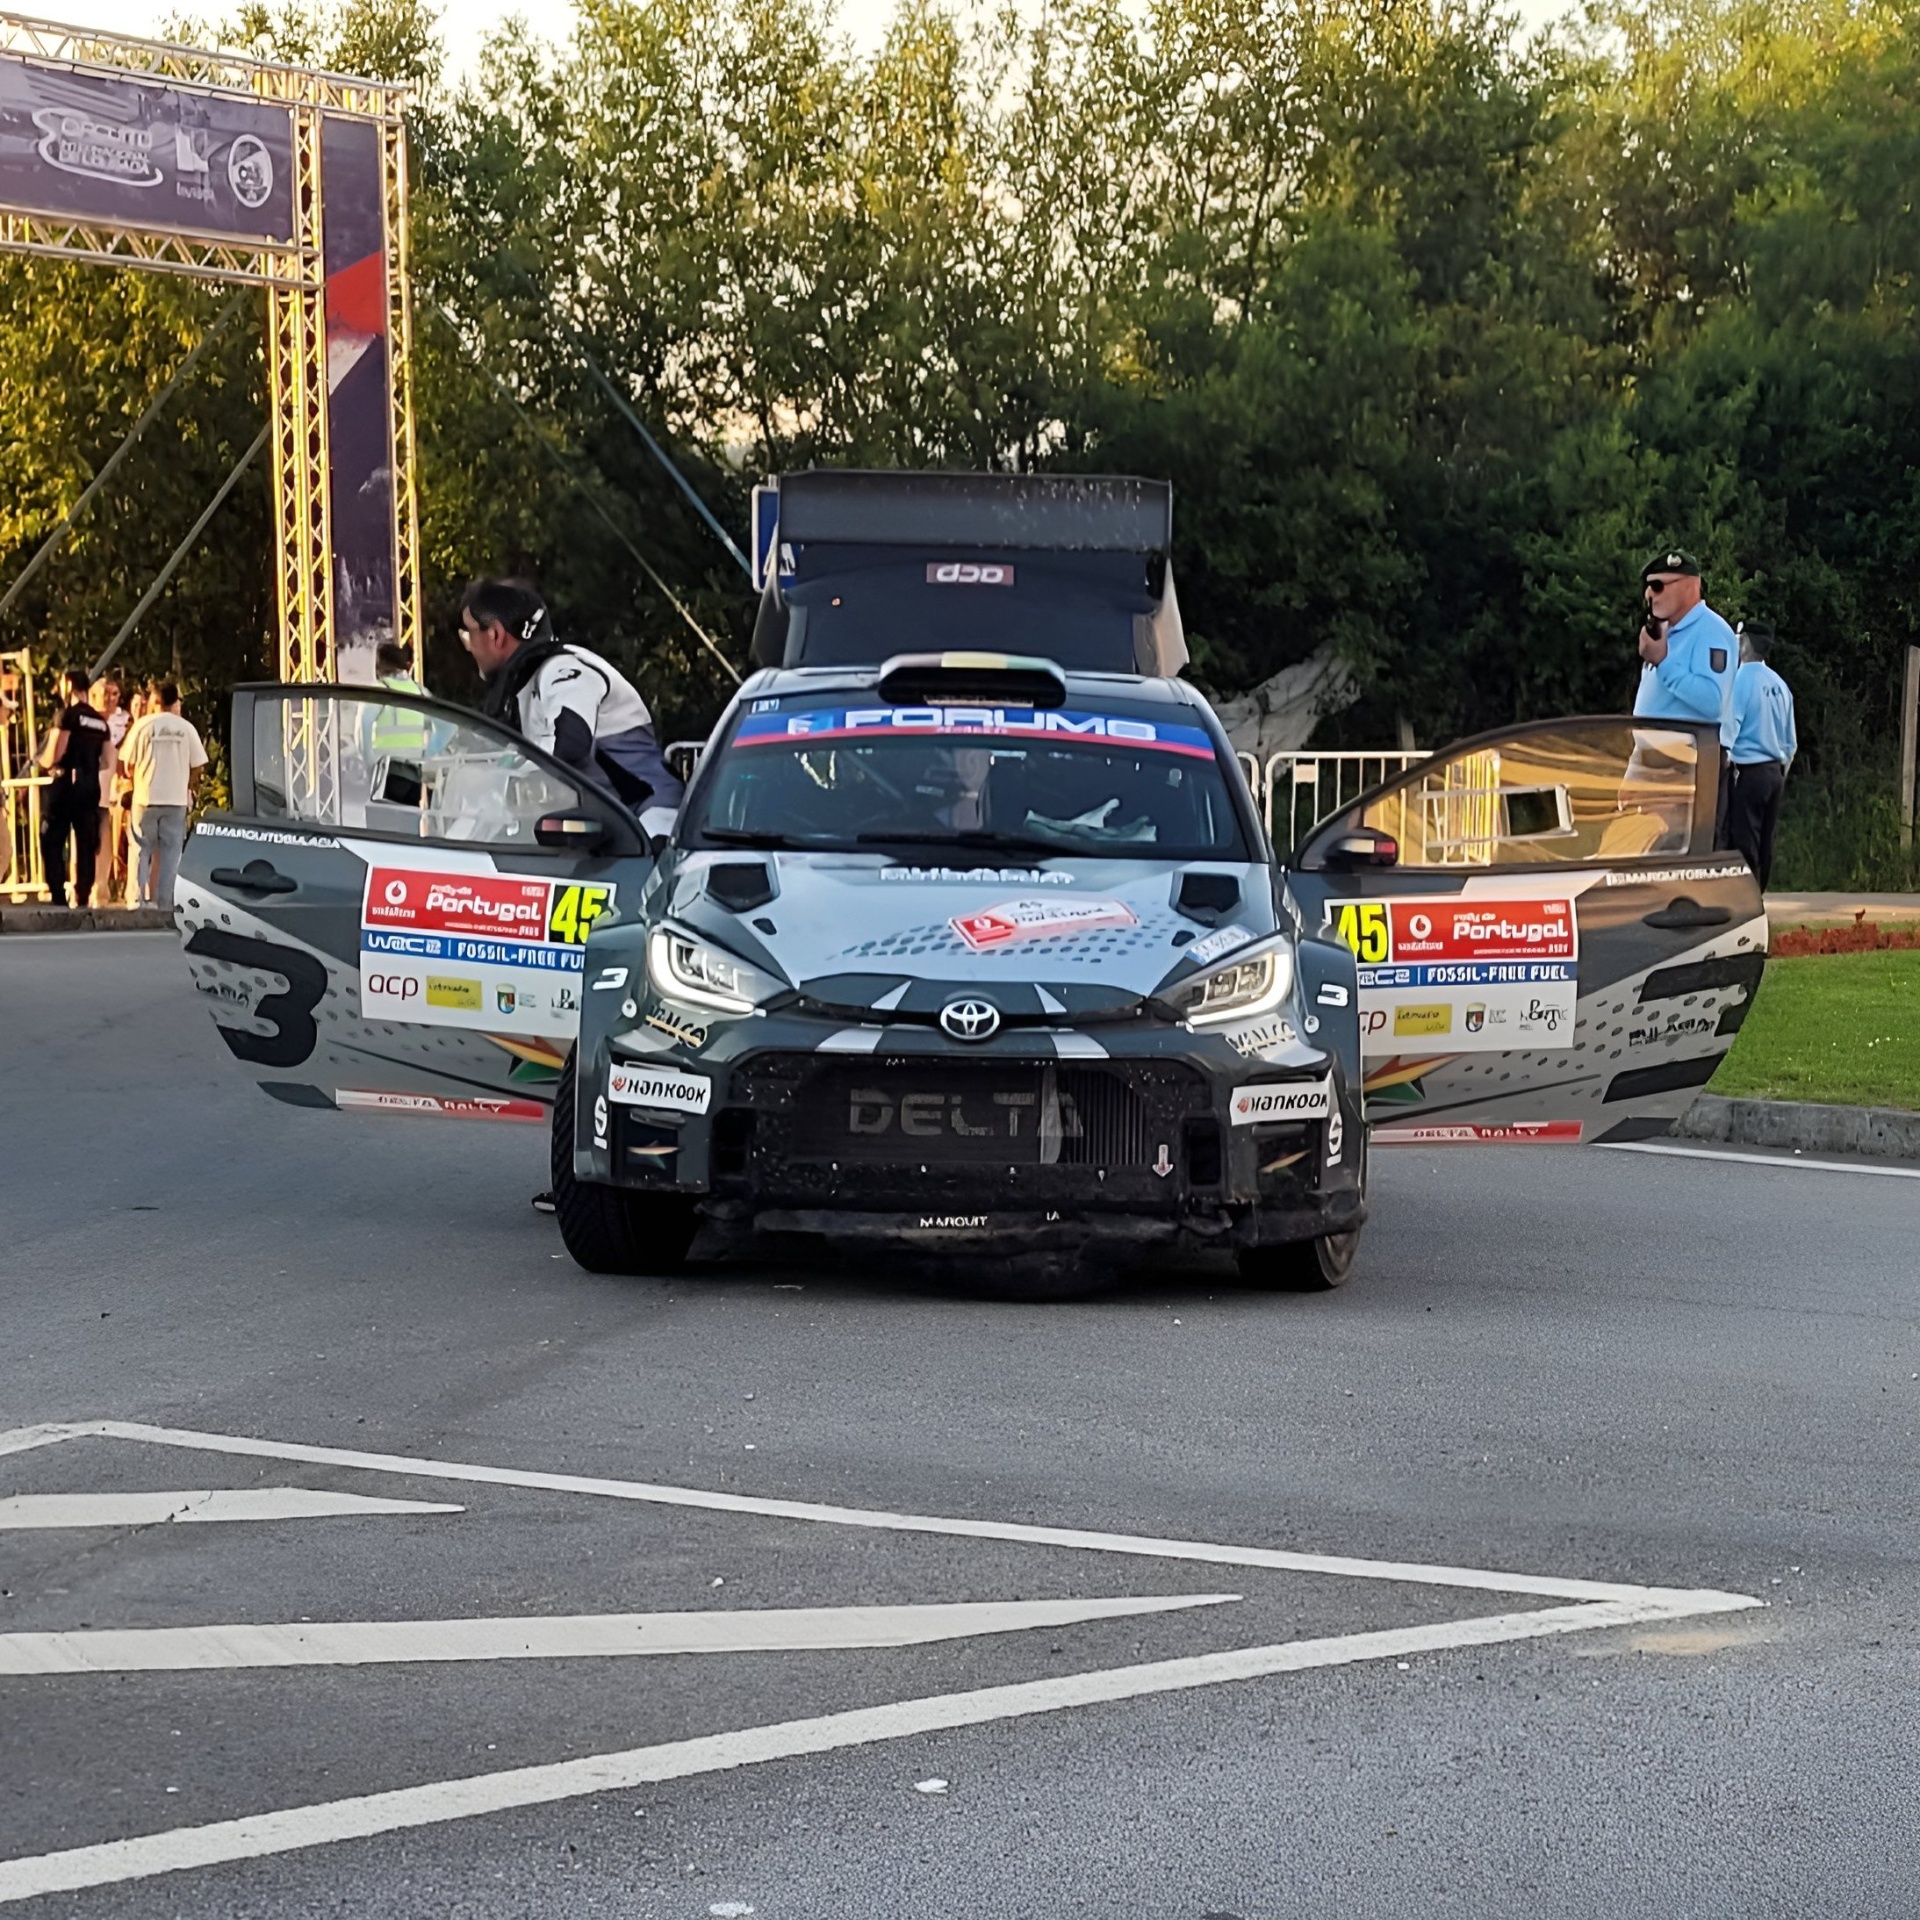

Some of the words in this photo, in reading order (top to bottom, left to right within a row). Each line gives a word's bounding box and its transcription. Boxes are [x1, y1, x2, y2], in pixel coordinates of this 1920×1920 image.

[426, 893, 542, 922] Portugal
[551, 886, 608, 944] 45
[1335, 904, 1389, 963] 45
[1453, 919, 1569, 943] Portugal
[368, 974, 419, 1001] acp
[850, 1087, 1084, 1137] DELTA
